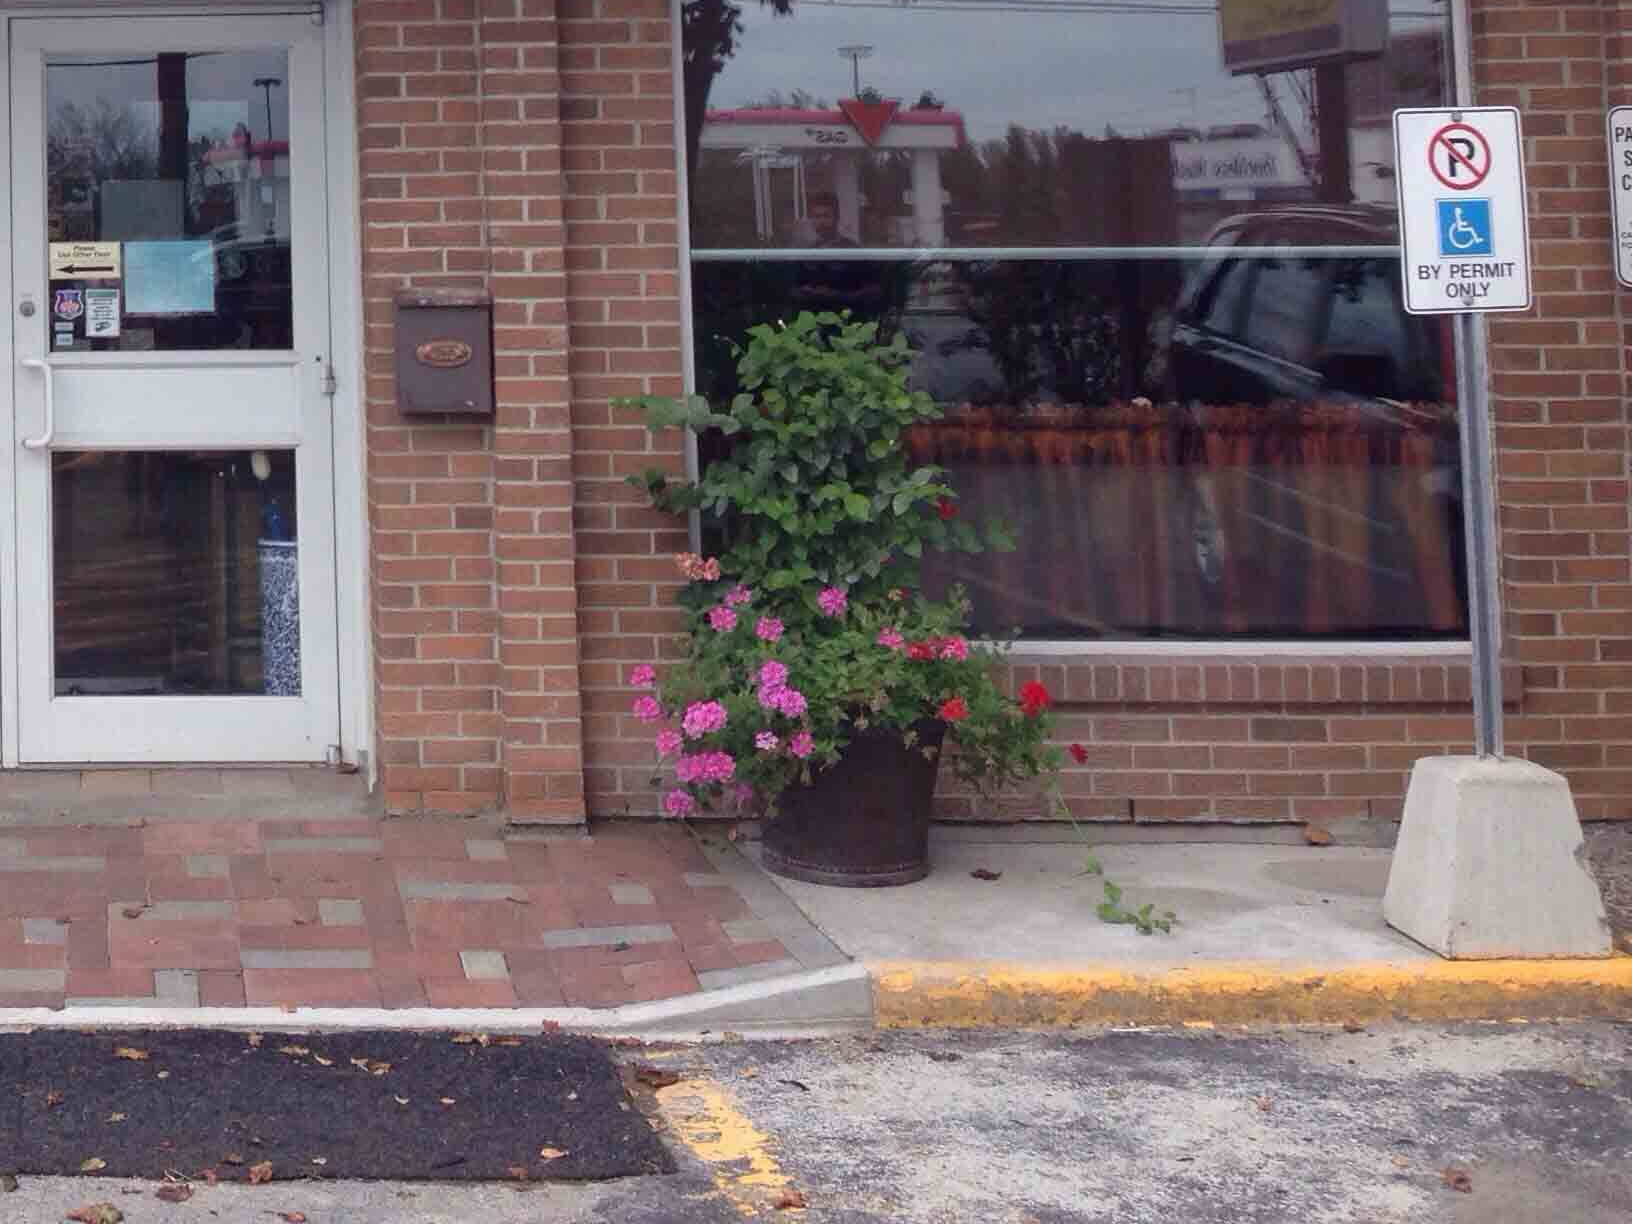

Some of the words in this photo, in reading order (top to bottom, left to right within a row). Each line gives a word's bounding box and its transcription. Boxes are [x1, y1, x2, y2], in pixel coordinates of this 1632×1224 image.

[1418, 264, 1441, 279] BY
[1449, 262, 1515, 279] PERMIT
[1446, 282, 1490, 298] ONLY
